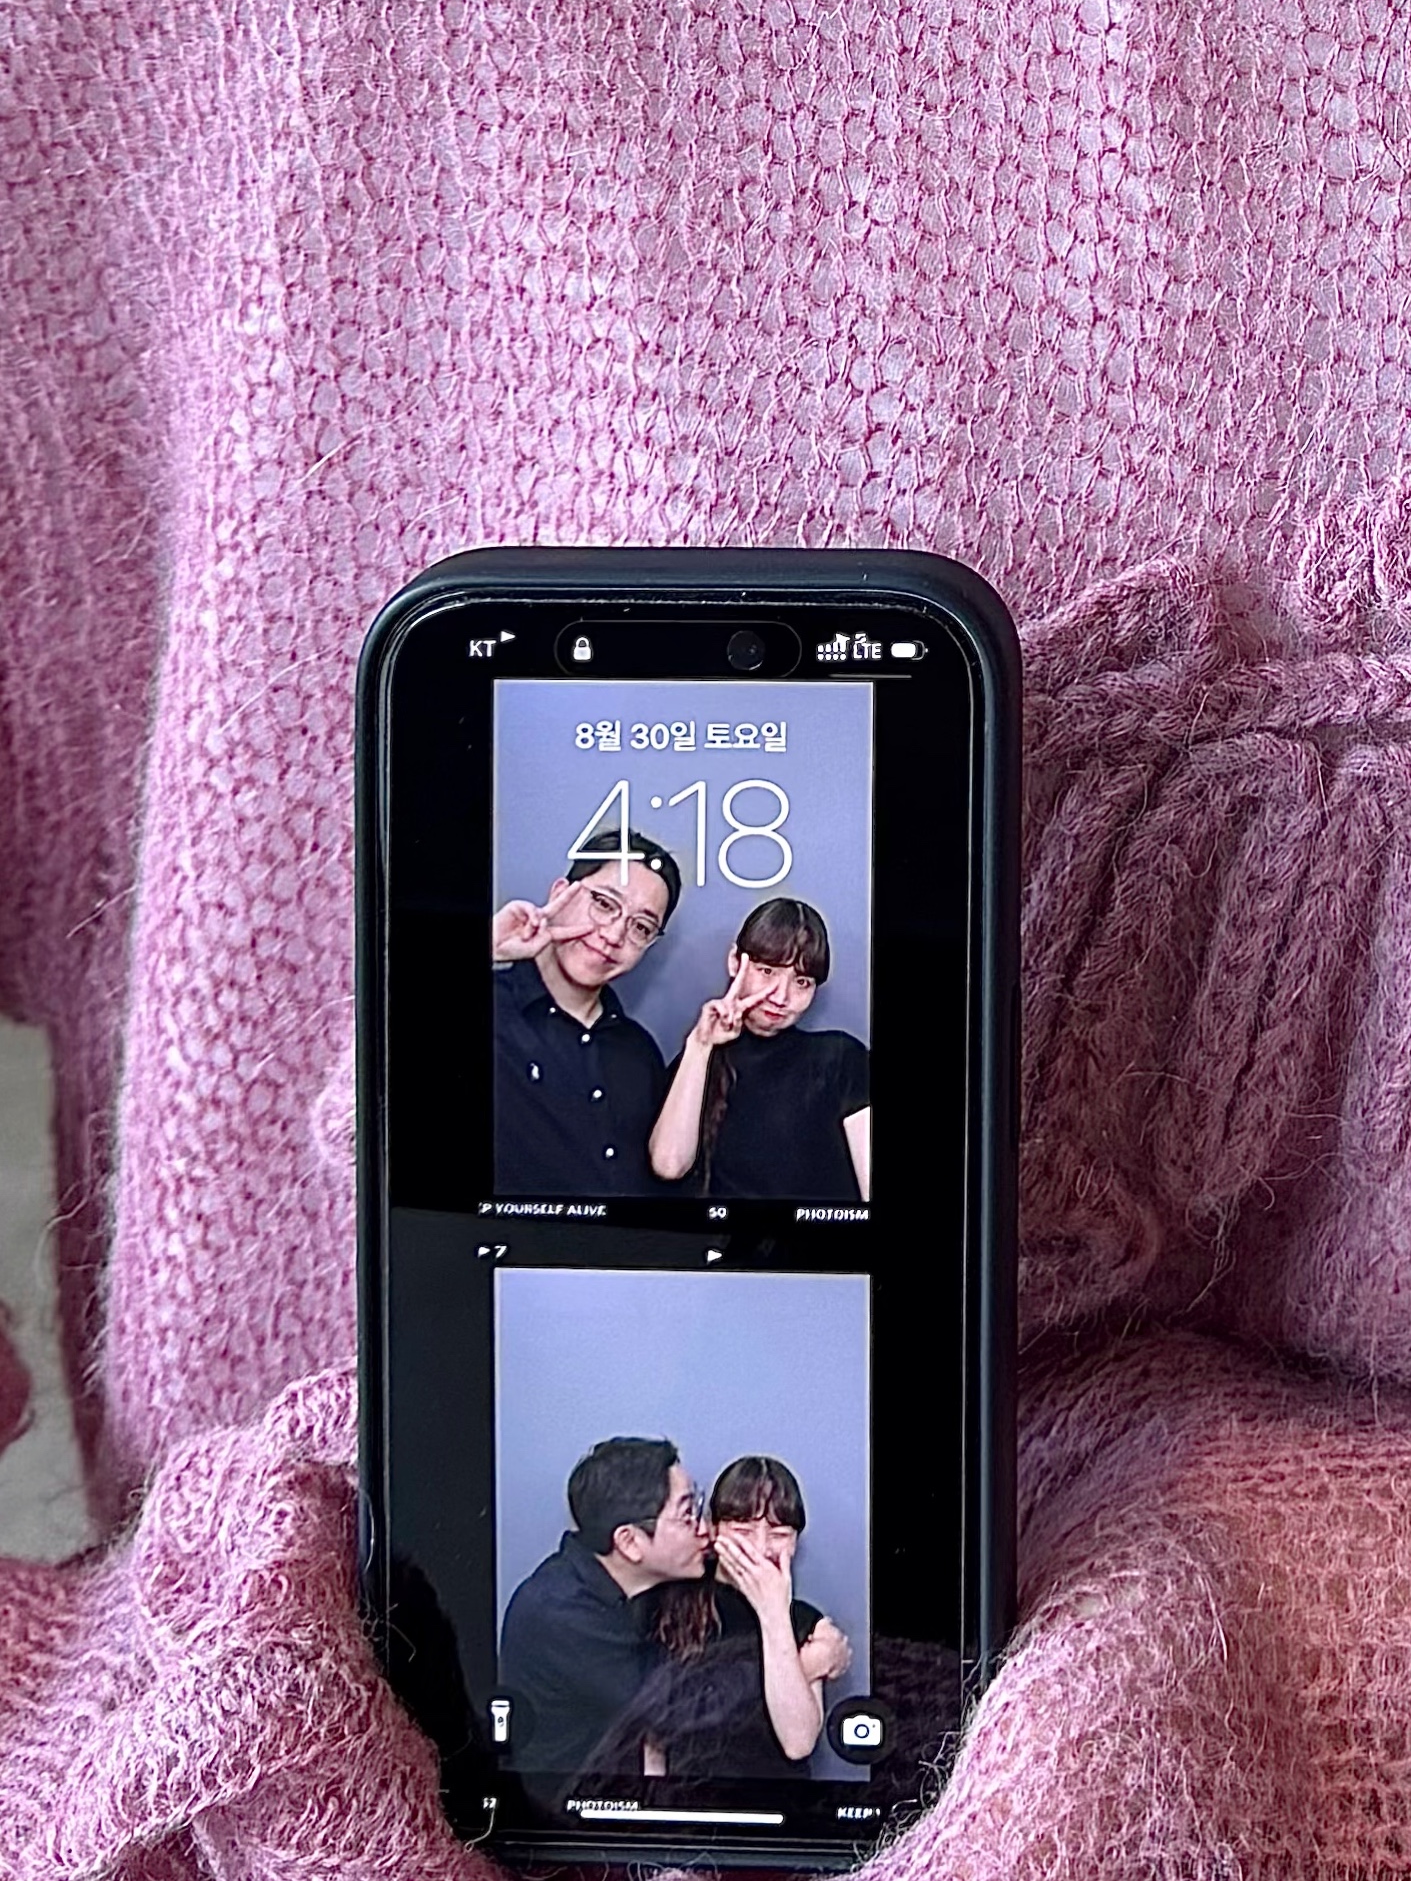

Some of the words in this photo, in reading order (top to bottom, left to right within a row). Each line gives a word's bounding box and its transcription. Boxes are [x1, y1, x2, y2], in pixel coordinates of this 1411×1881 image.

[469, 639, 497, 658] KT
[852, 641, 882, 660] LTE
[575, 720, 622, 752] 8월
[630, 720, 697, 752] 30일
[703, 721, 787, 753] 토요일
[567, 779, 793, 888] 4:18
[495, 1203, 564, 1216] YOURSELF
[796, 1208, 869, 1221] PHOTOISM
